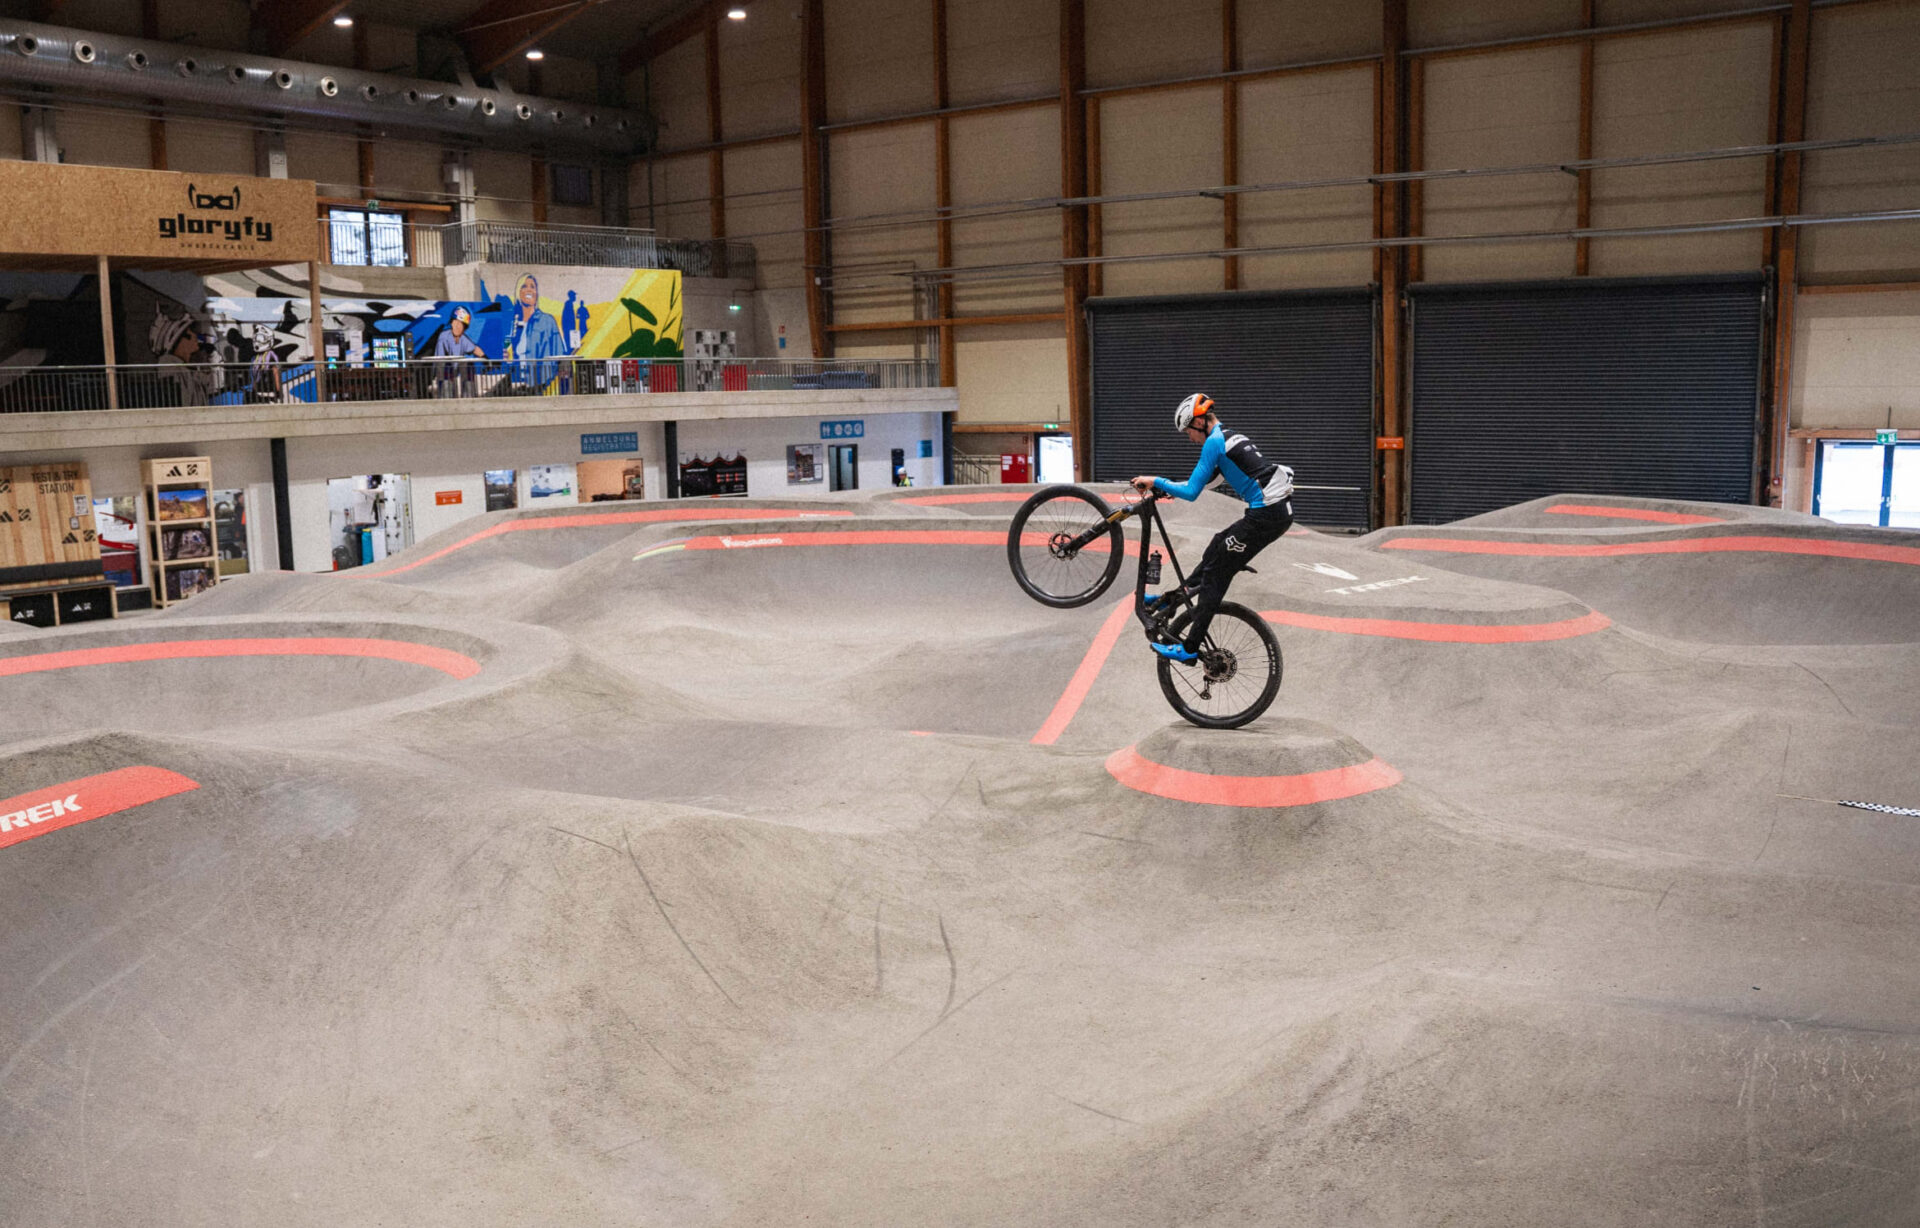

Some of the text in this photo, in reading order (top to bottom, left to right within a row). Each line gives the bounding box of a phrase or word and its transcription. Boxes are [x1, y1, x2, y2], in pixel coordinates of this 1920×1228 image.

[159, 213, 273, 242] gloryfy
[583, 434, 637, 444] ANMELDUNG
[583, 442, 636, 452] REGISTRATION
[31, 470, 79, 483] TEST & TRY
[39, 482, 75, 495] STATION
